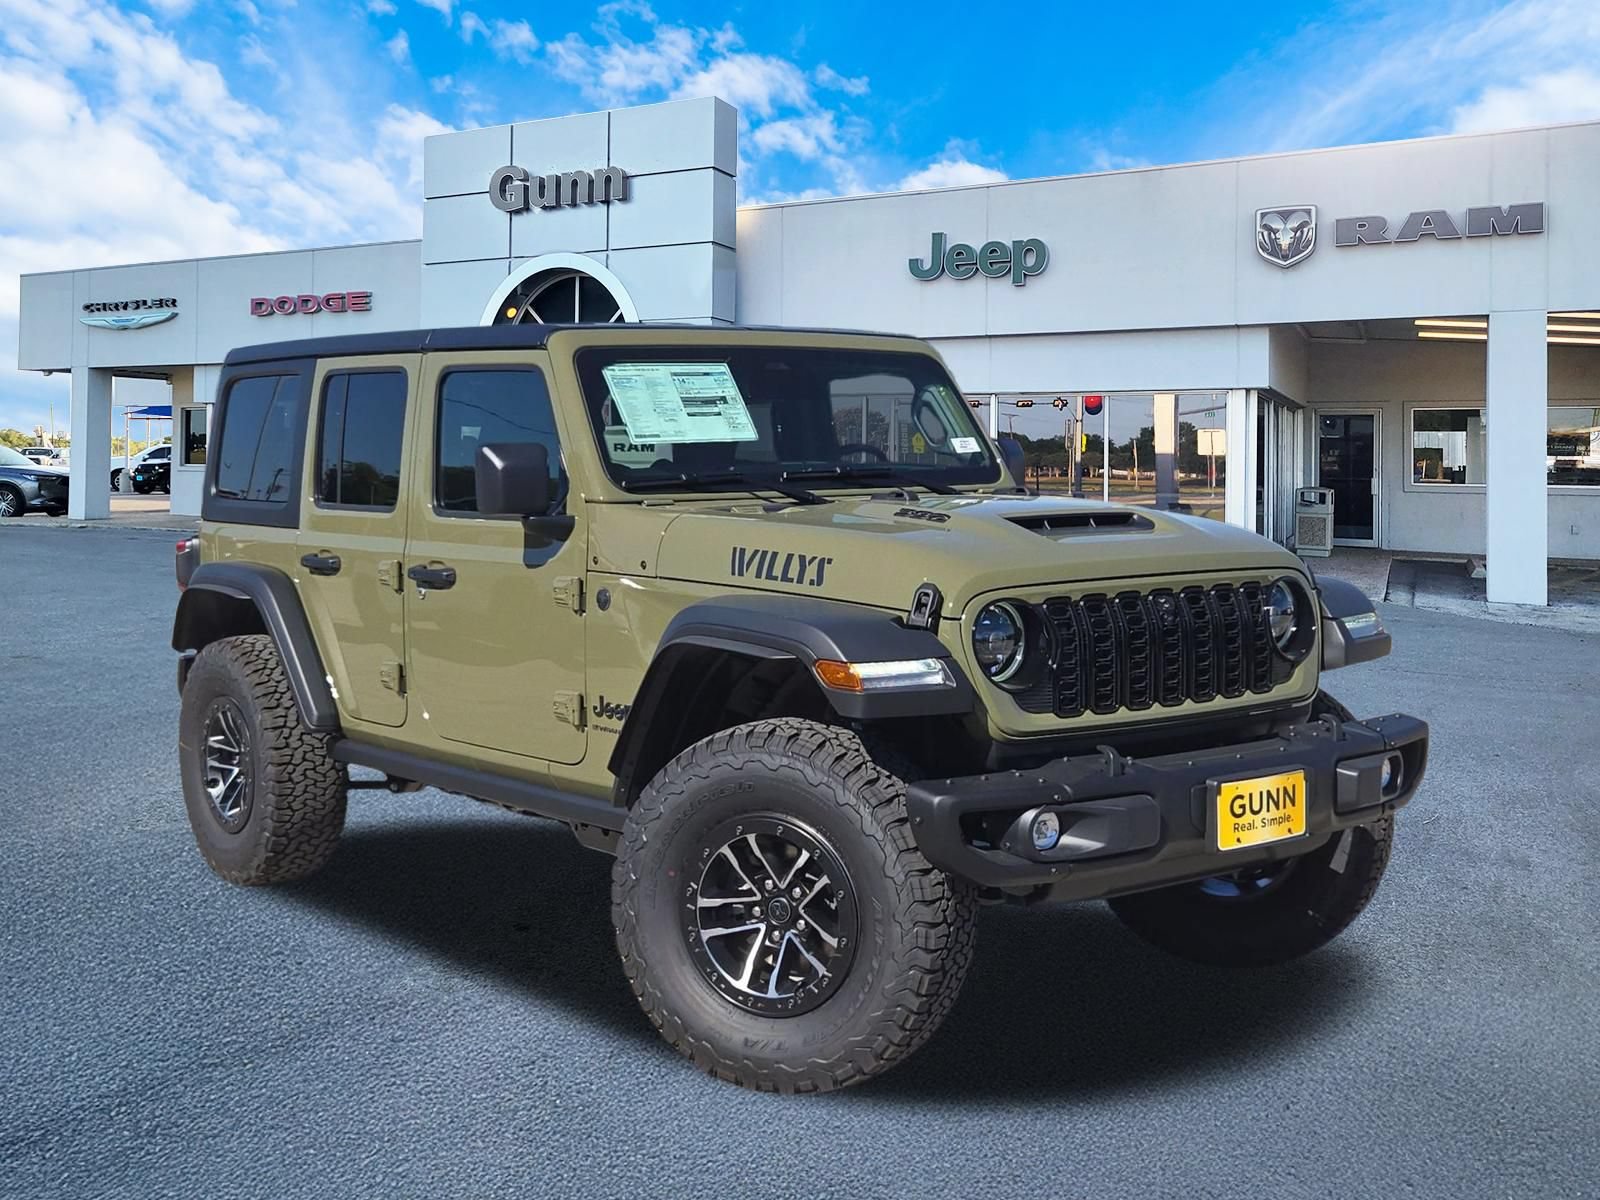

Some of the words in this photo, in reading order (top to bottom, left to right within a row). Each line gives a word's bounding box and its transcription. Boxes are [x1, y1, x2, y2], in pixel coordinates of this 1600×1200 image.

[489, 165, 627, 213] Gunn
[1335, 202, 1545, 247] RAM
[908, 232, 1050, 286] Jeep
[82, 298, 178, 313] CHRYSLER
[251, 292, 372, 316] DODGE
[613, 443, 656, 452] RAM
[731, 546, 833, 587] WILLYS
[1229, 784, 1296, 818] GUNN
[1233, 819, 1258, 833] Real.
[1261, 813, 1294, 829] Simple.
